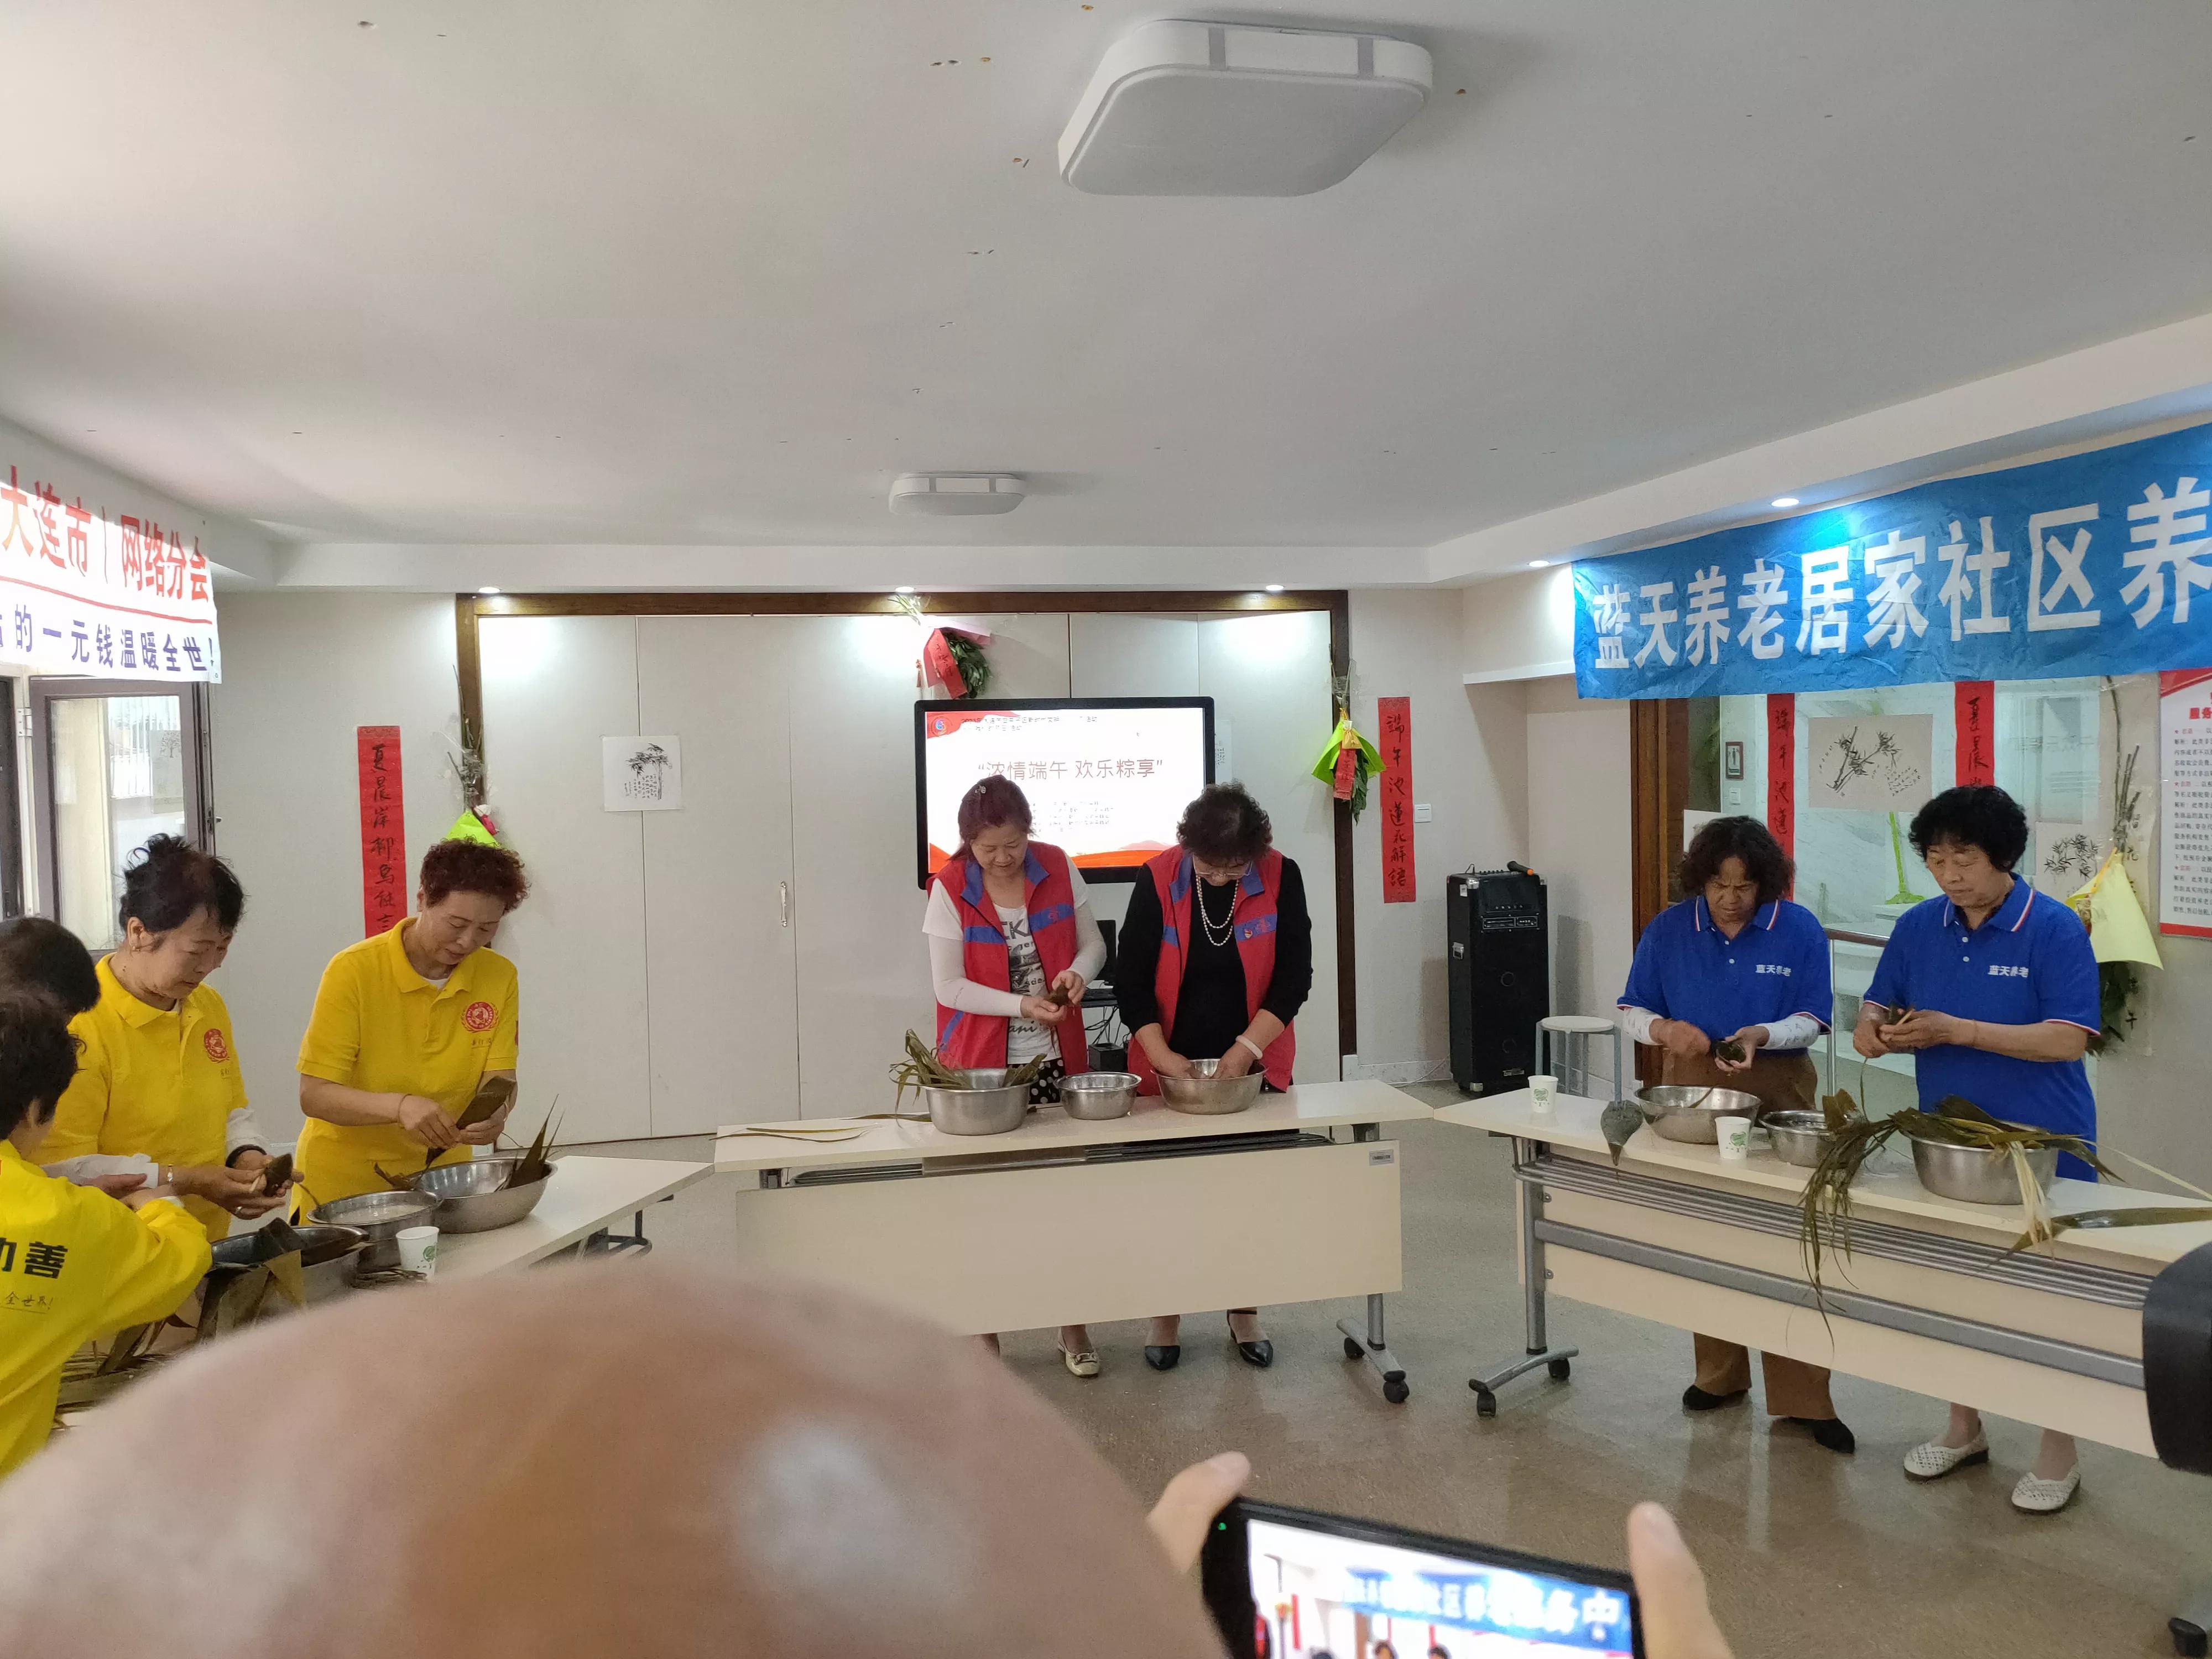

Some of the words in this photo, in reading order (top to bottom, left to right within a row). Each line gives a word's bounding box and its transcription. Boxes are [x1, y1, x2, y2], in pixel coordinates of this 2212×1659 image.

[0, 604, 214, 671] 的一元钱温暖全世!
[1593, 476, 2212, 670] 蓝天养老居家社区养
